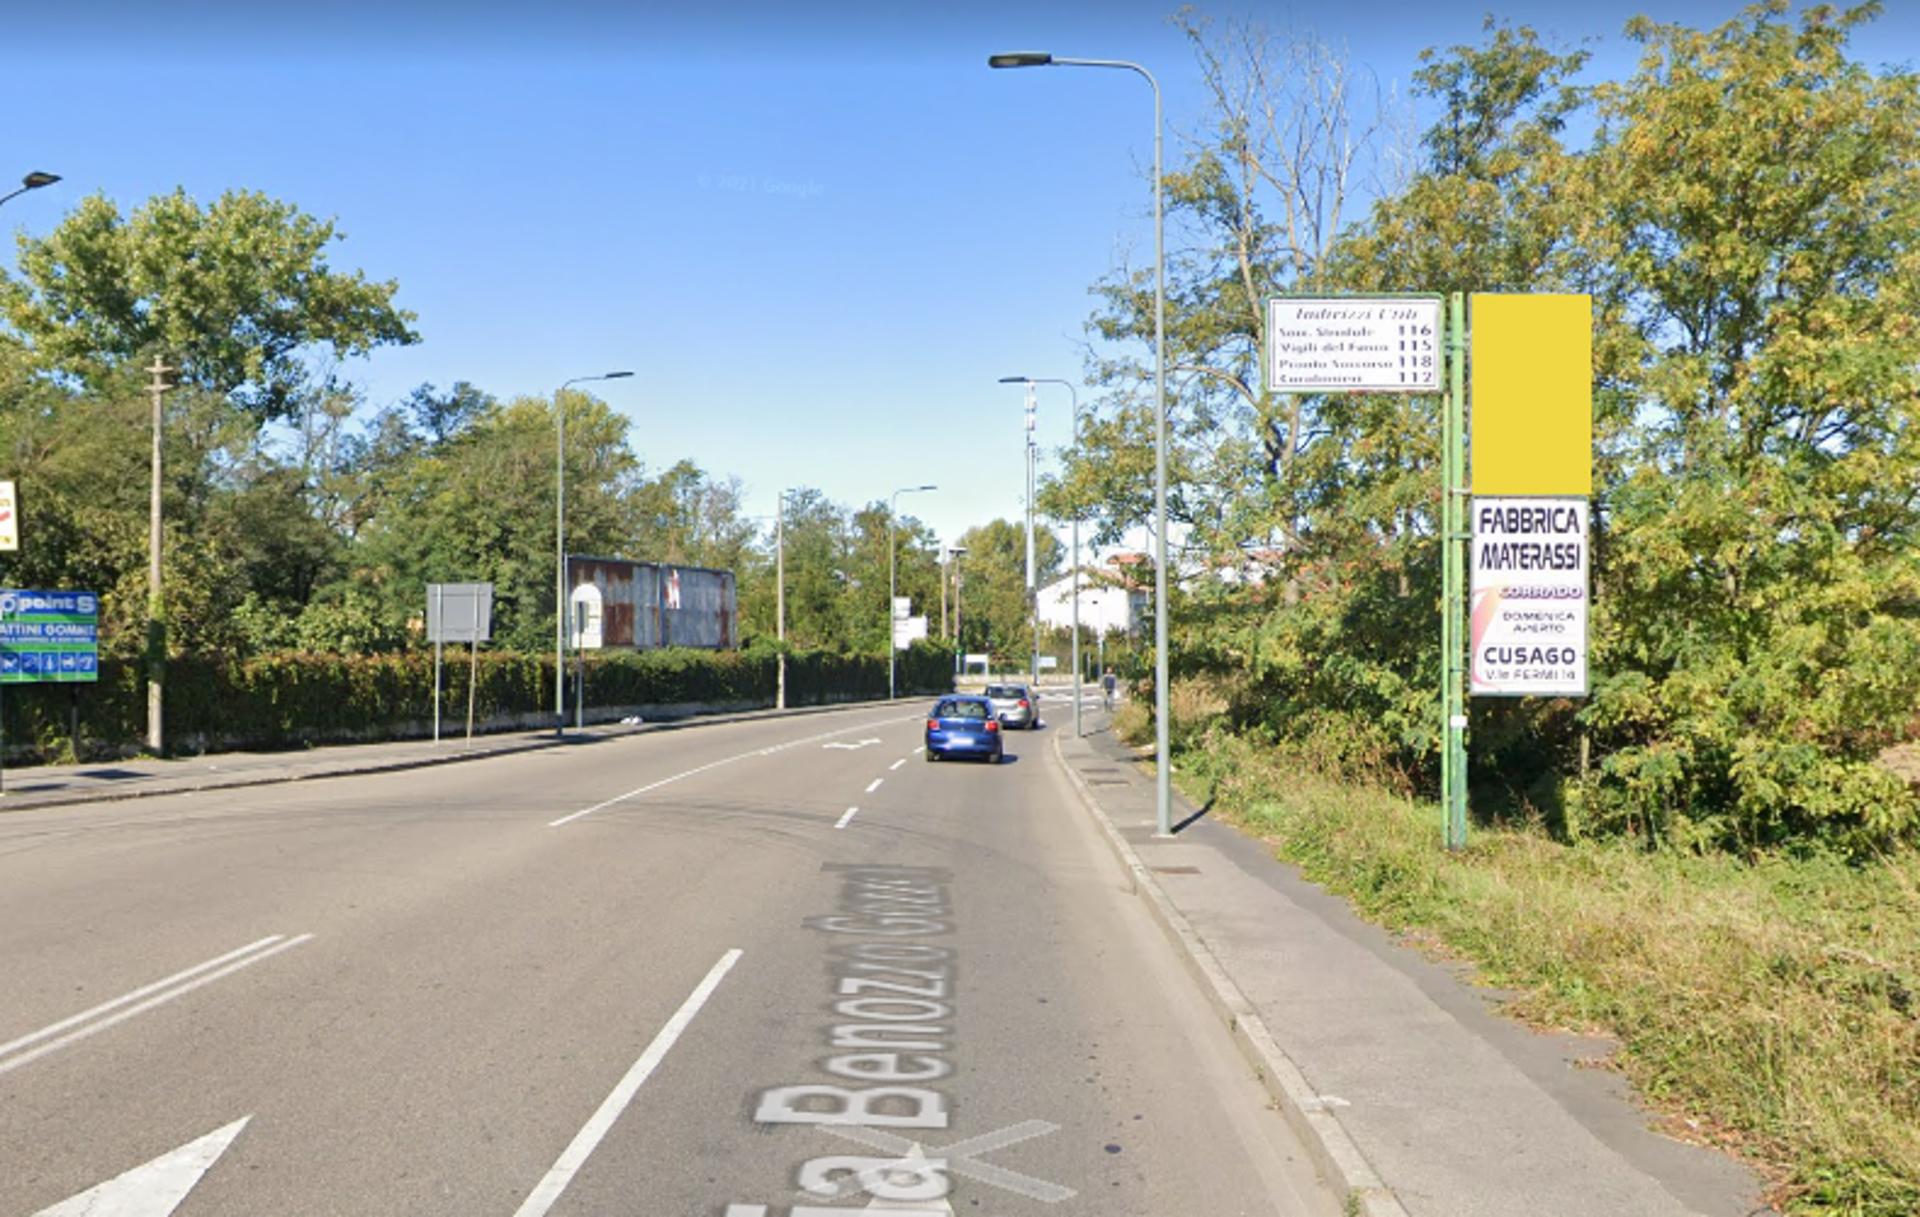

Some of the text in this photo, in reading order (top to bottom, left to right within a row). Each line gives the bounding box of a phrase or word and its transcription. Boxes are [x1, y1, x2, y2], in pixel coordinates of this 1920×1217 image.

[1399, 325, 1432, 336] 116
[1323, 342, 1344, 352] del
[1399, 340, 1432, 351] 115
[1399, 356, 1432, 368] 118
[1399, 372, 1432, 383] 112
[1479, 507, 1580, 534] FABBRICA
[1479, 542, 1580, 570] MATERASSI
[19, 595, 96, 614] point S
[1503, 611, 1575, 622] DOMENICA
[1513, 623, 1565, 634] APERTO
[1484, 646, 1576, 665] CUSAGO
